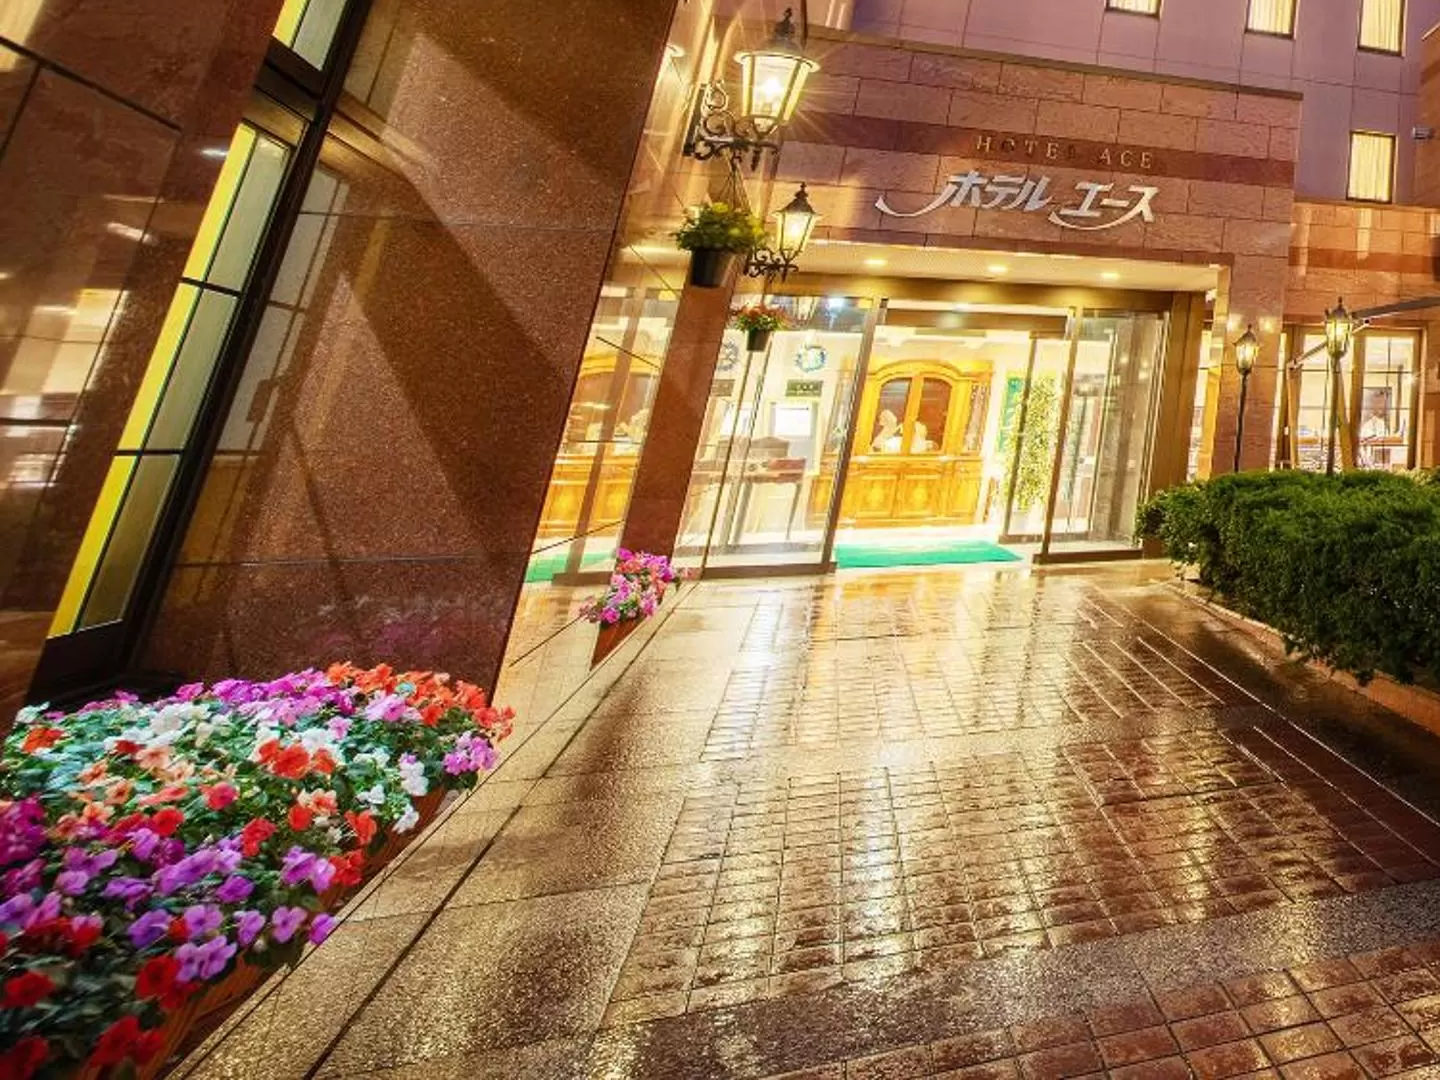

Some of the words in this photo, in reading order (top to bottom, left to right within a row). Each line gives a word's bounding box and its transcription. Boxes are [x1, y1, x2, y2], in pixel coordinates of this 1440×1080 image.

[1099, 148, 1153, 169] ACE
[875, 170, 1052, 218] ホテル
[1048, 181, 1159, 231] エース
